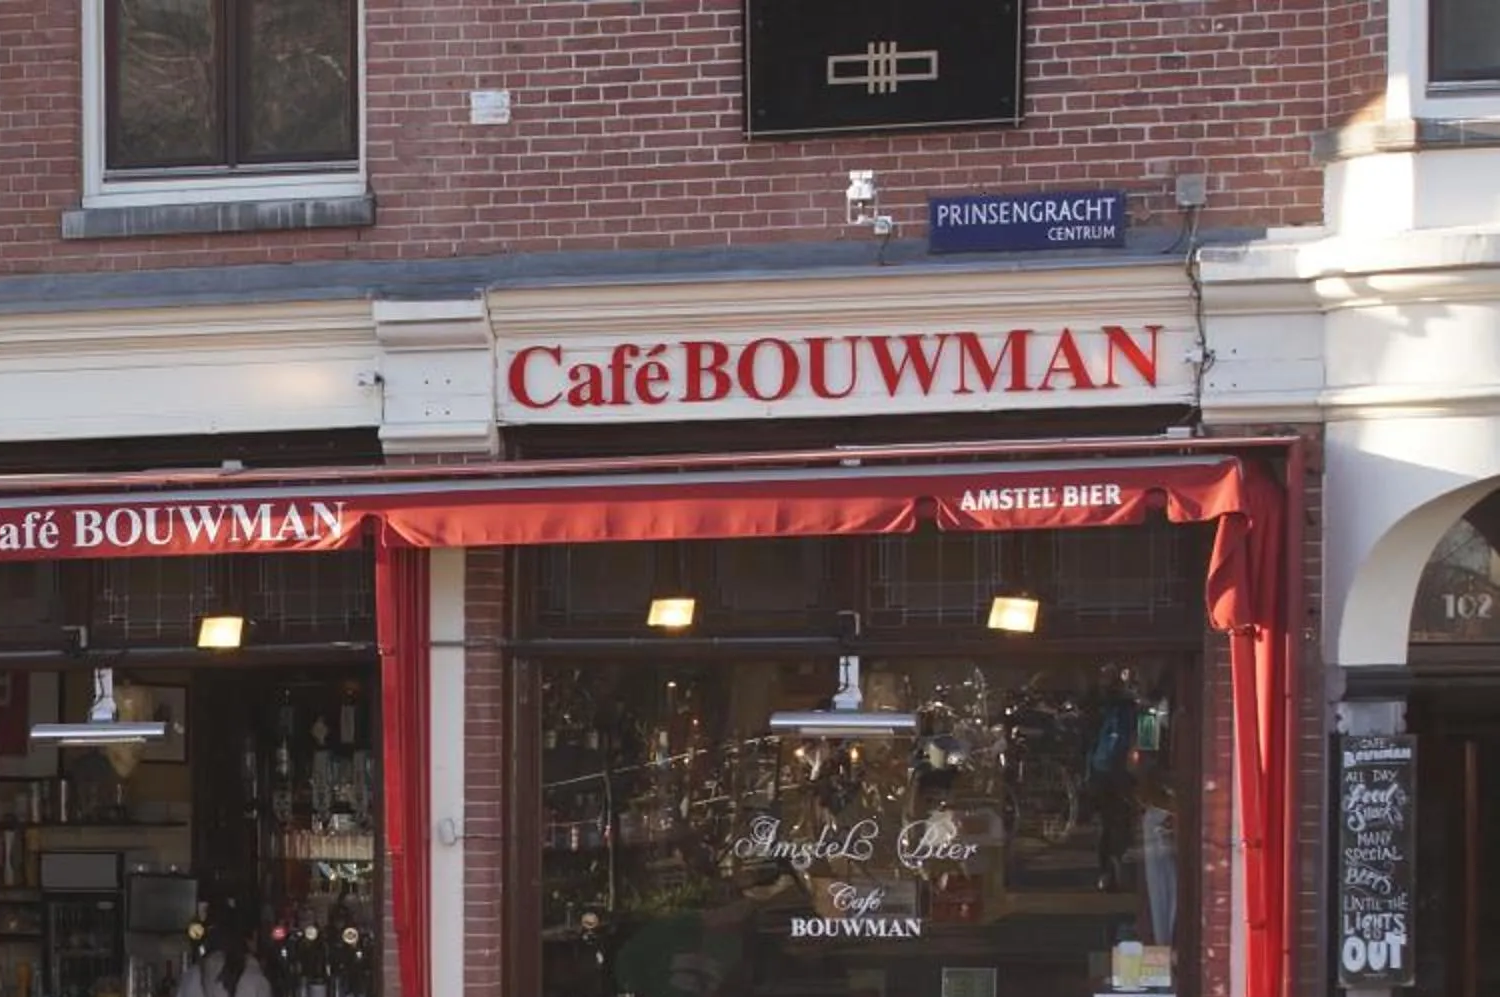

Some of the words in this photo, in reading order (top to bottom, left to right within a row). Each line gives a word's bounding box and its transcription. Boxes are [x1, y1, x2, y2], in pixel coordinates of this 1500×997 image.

[937, 197, 1117, 227] PRINSENGRACHT
[1047, 225, 1116, 241] CENTRUM
[507, 343, 670, 409] Café
[679, 325, 1164, 403] BOUWMAN
[960, 488, 1057, 511] AMSTEL
[1062, 484, 1122, 508] BIER
[72, 500, 345, 549] BOUWMAN
[1441, 593, 1493, 619] 102
[1345, 771, 1365, 783] ALL
[1372, 769, 1399, 782] DAY
[1356, 830, 1394, 847] MANY
[1344, 845, 1404, 863] SPECIAL
[828, 881, 886, 919] Café
[790, 917, 922, 938] BOUWMAN
[1342, 931, 1408, 973] OUT
